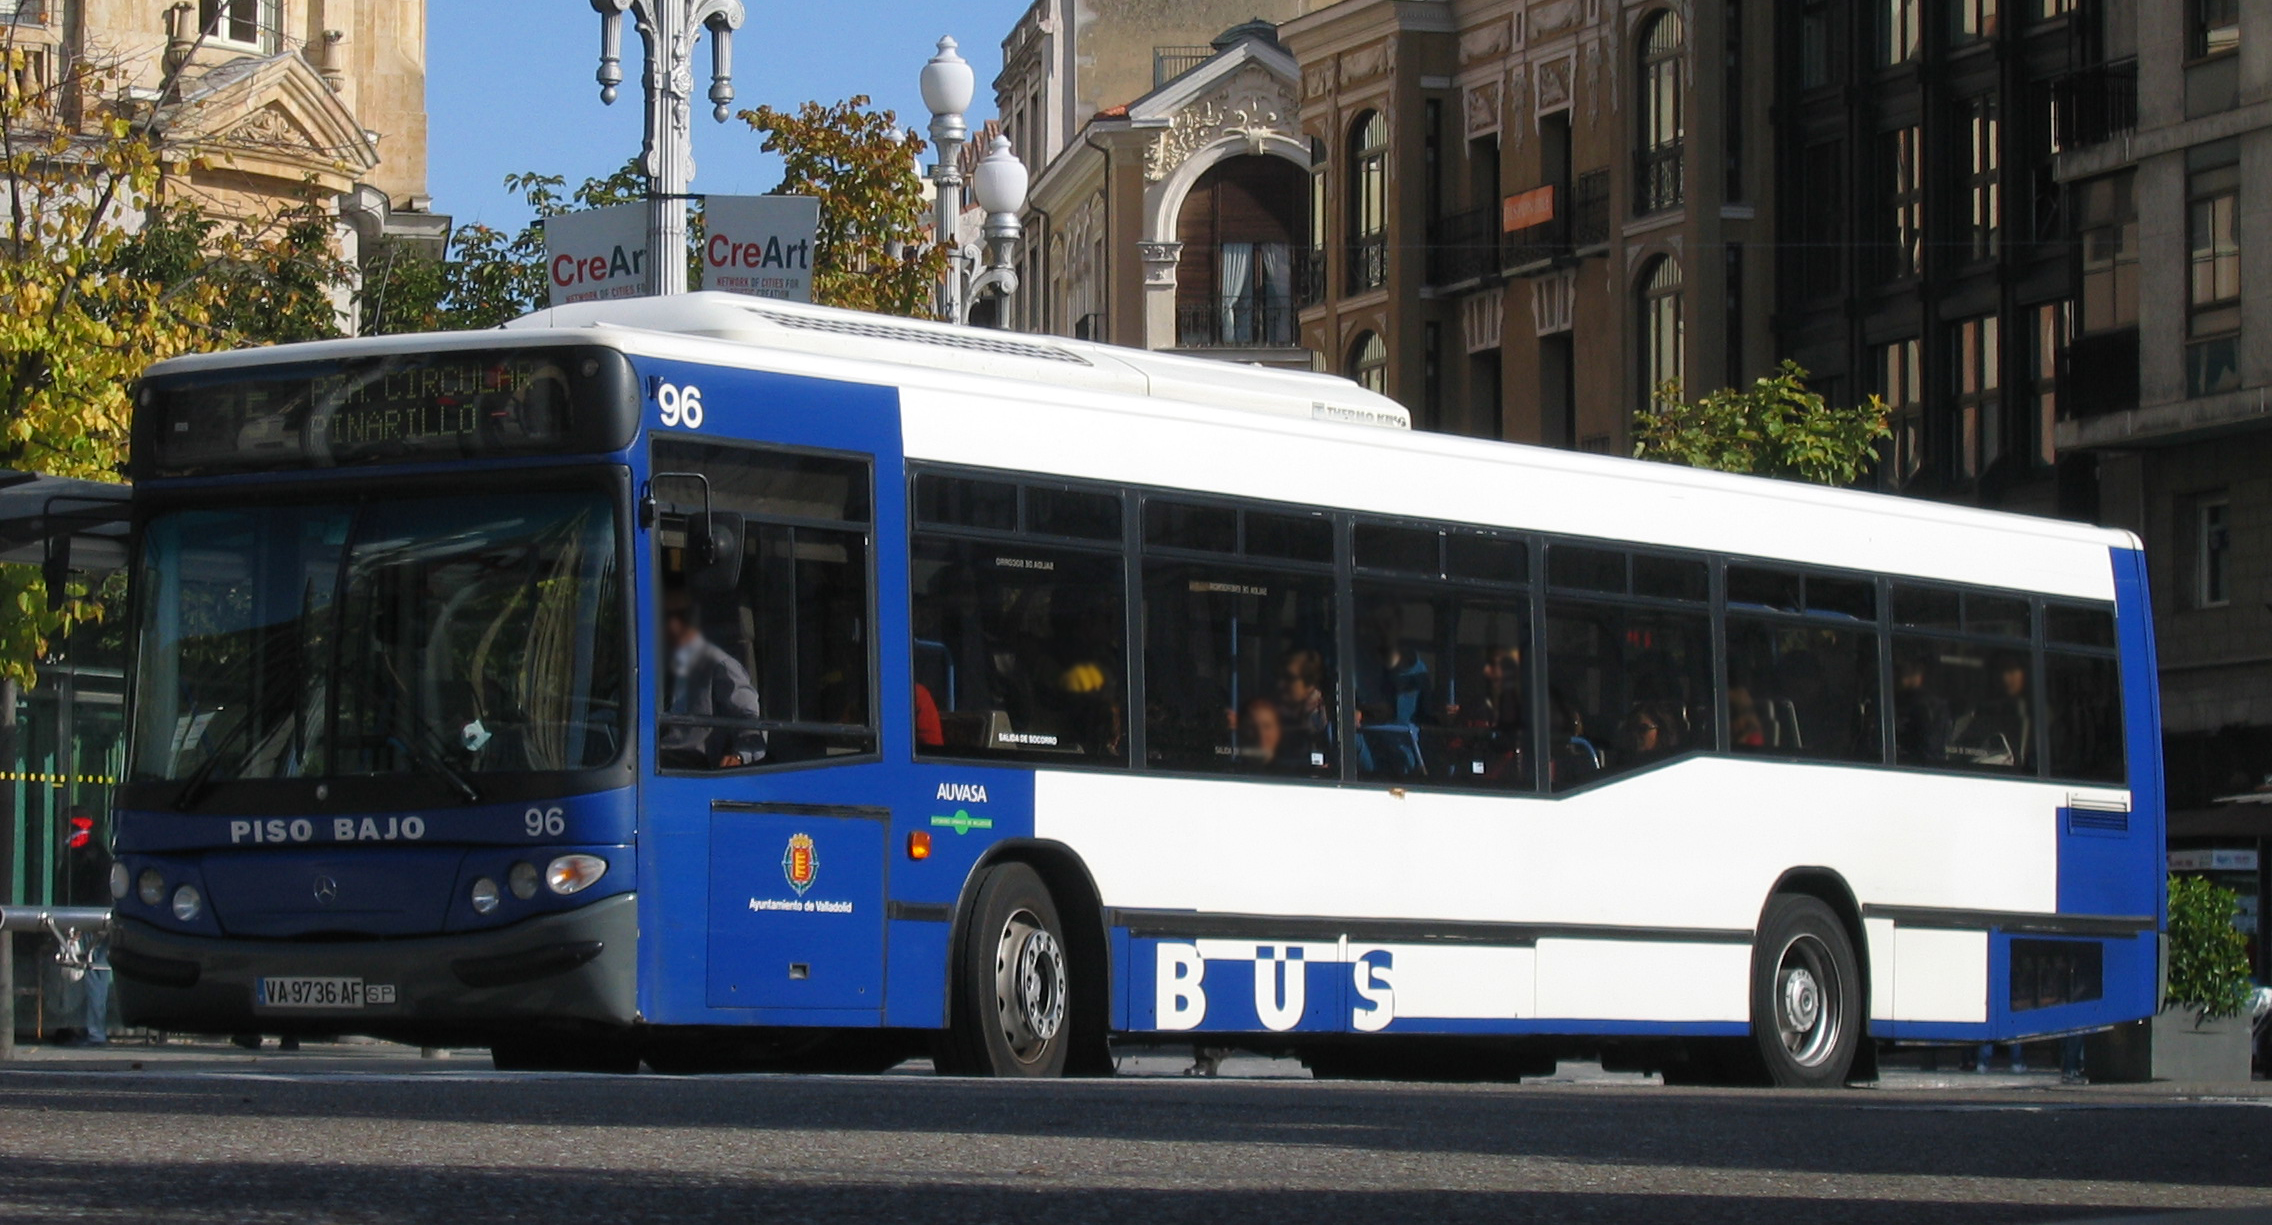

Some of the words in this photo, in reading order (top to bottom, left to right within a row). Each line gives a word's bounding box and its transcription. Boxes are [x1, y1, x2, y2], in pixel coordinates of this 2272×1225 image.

[708, 233, 808, 269] CreArt
[552, 245, 648, 287] CreAr
[717, 276, 748, 287] NETWORK
[751, 277, 760, 287] OF
[761, 278, 784, 288] CITIES
[786, 278, 799, 289] FOR
[384, 360, 534, 402] CIRCULAR
[658, 382, 704, 429] 96
[1326, 406, 1374, 421] THERMO
[998, 732, 1019, 743] SALIDA
[1019, 733, 1028, 744] DE
[1028, 734, 1058, 746] SOCORRO
[936, 783, 988, 803] AUVASA
[230, 819, 314, 843] PISO
[333, 816, 426, 841] BAJO
[524, 807, 566, 837] 96
[749, 898, 803, 912] Ayuntamiento
[804, 901, 815, 912] de
[815, 901, 853, 913] Valladolid
[367, 985, 393, 1002] SP
